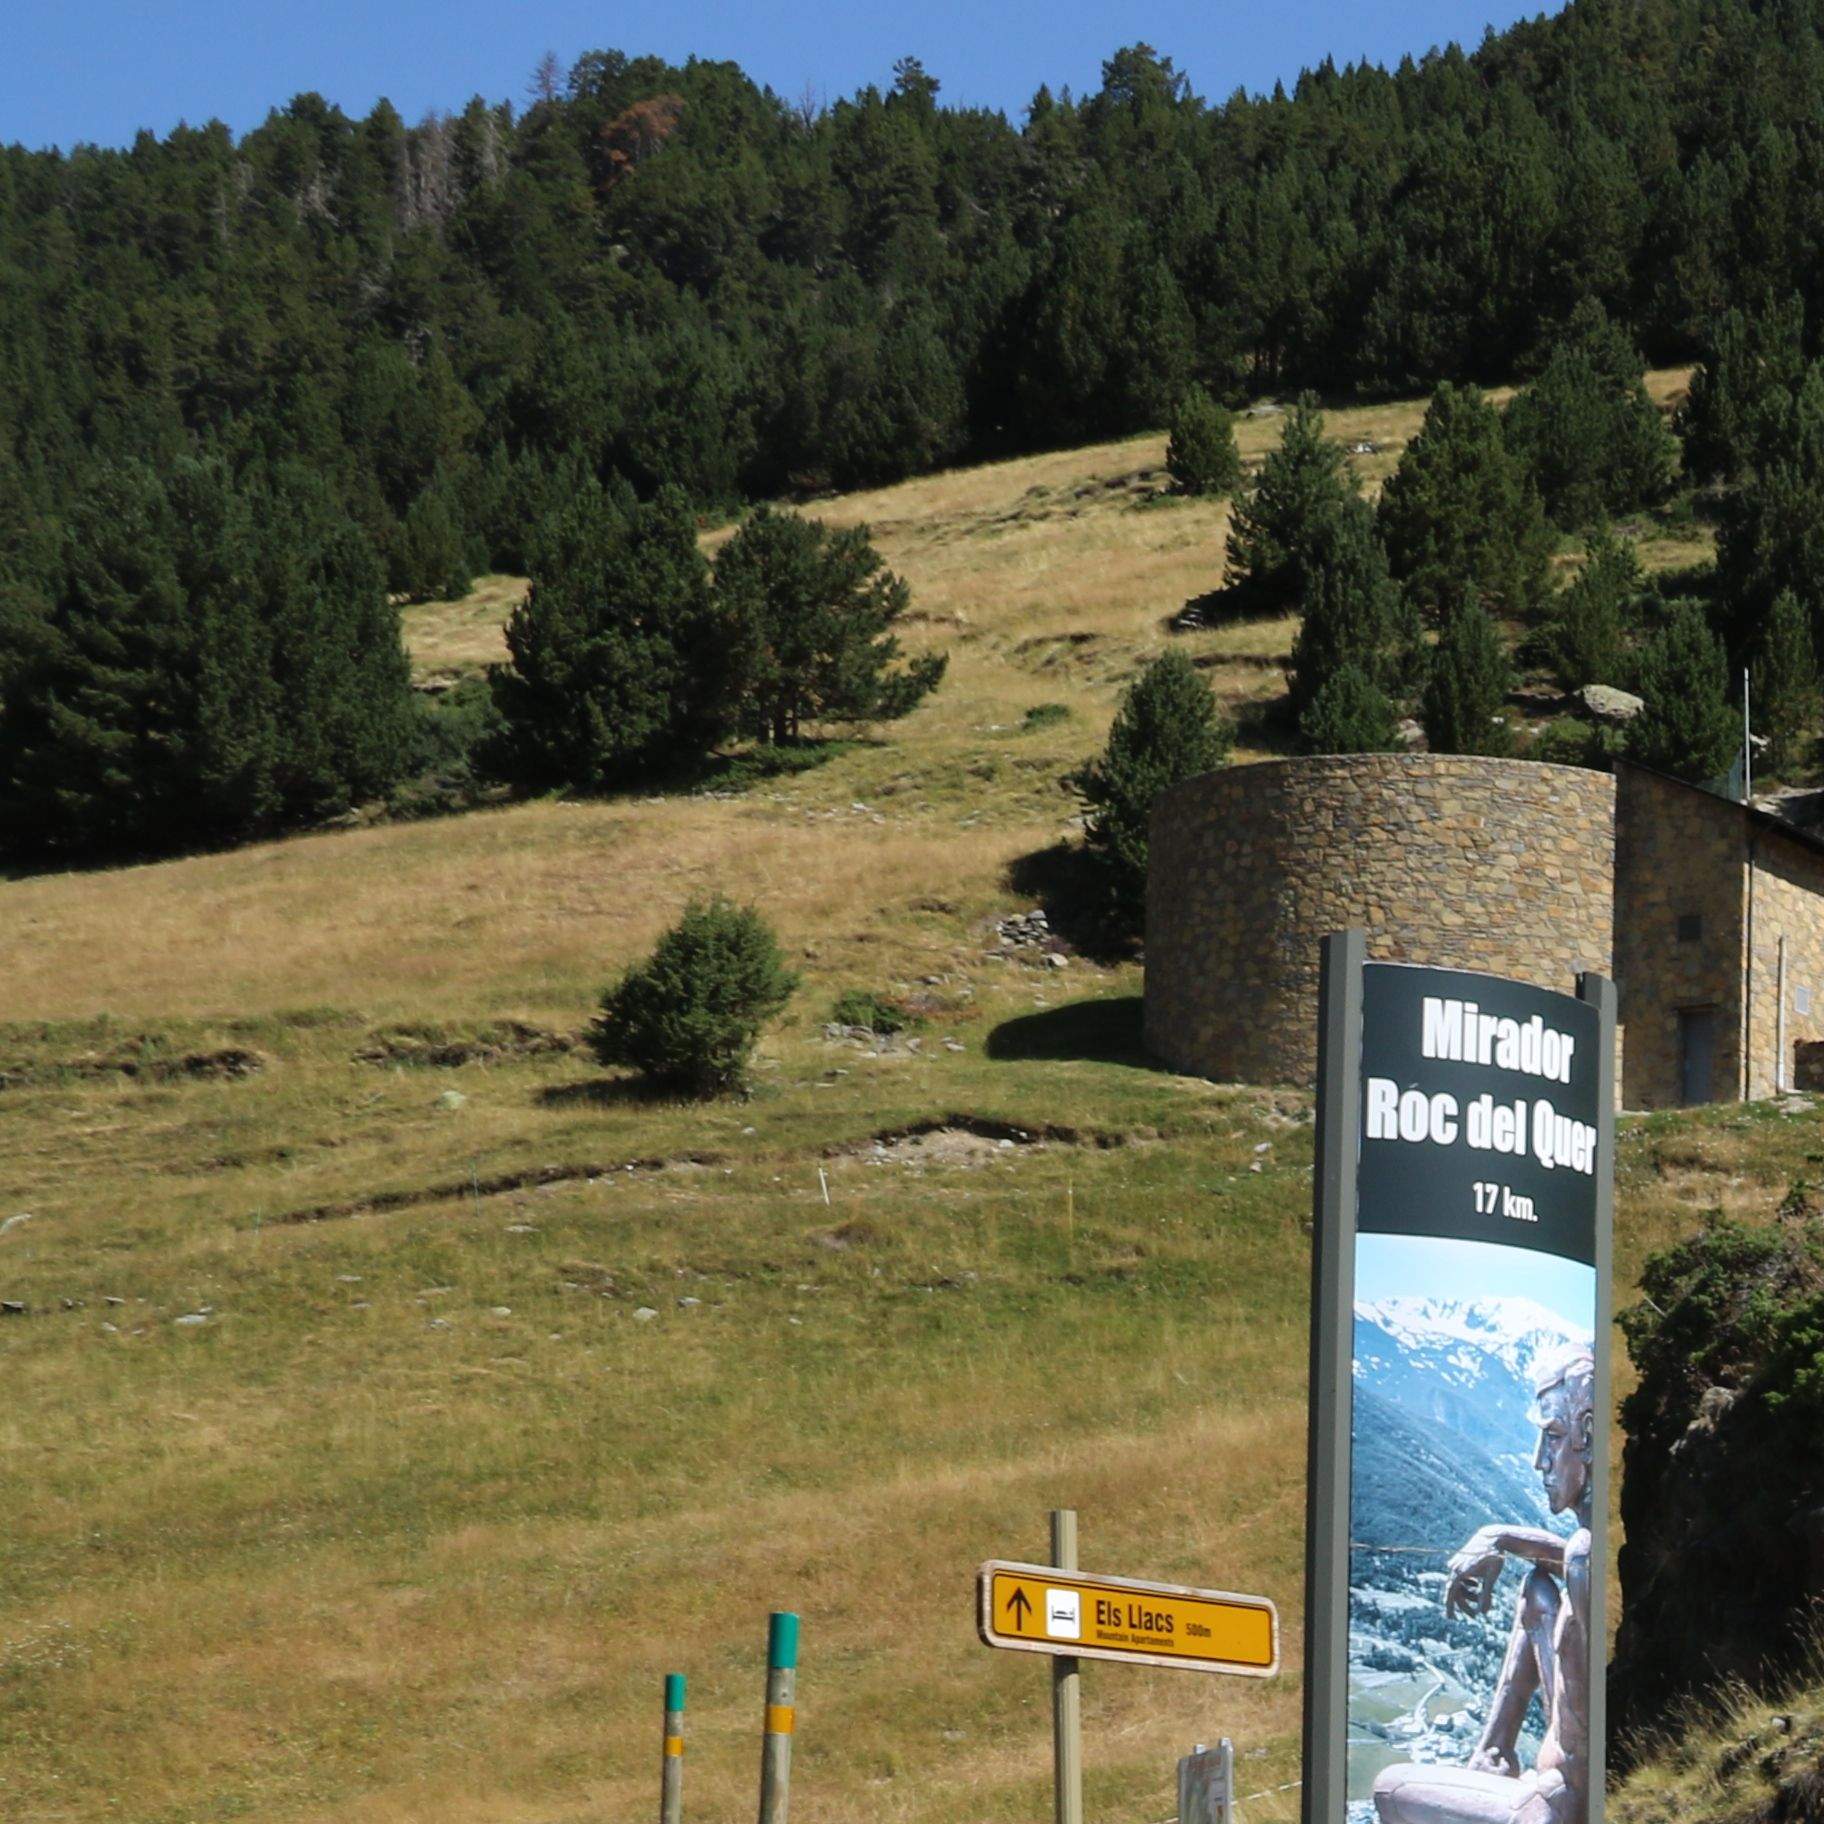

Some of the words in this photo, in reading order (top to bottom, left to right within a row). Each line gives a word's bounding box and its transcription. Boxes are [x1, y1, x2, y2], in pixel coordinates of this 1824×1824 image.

[1422, 997, 1575, 1084] Mirador
[1366, 1078, 1459, 1145] Roc
[1467, 1094, 1527, 1155] del
[1532, 1099, 1597, 1175] Quer
[1472, 1182, 1499, 1214] 17
[1503, 1186, 1538, 1222] km.
[1096, 1599, 1122, 1627] Els
[1128, 1604, 1174, 1633] Llacs
[1096, 1629, 1129, 1642] Mountain
